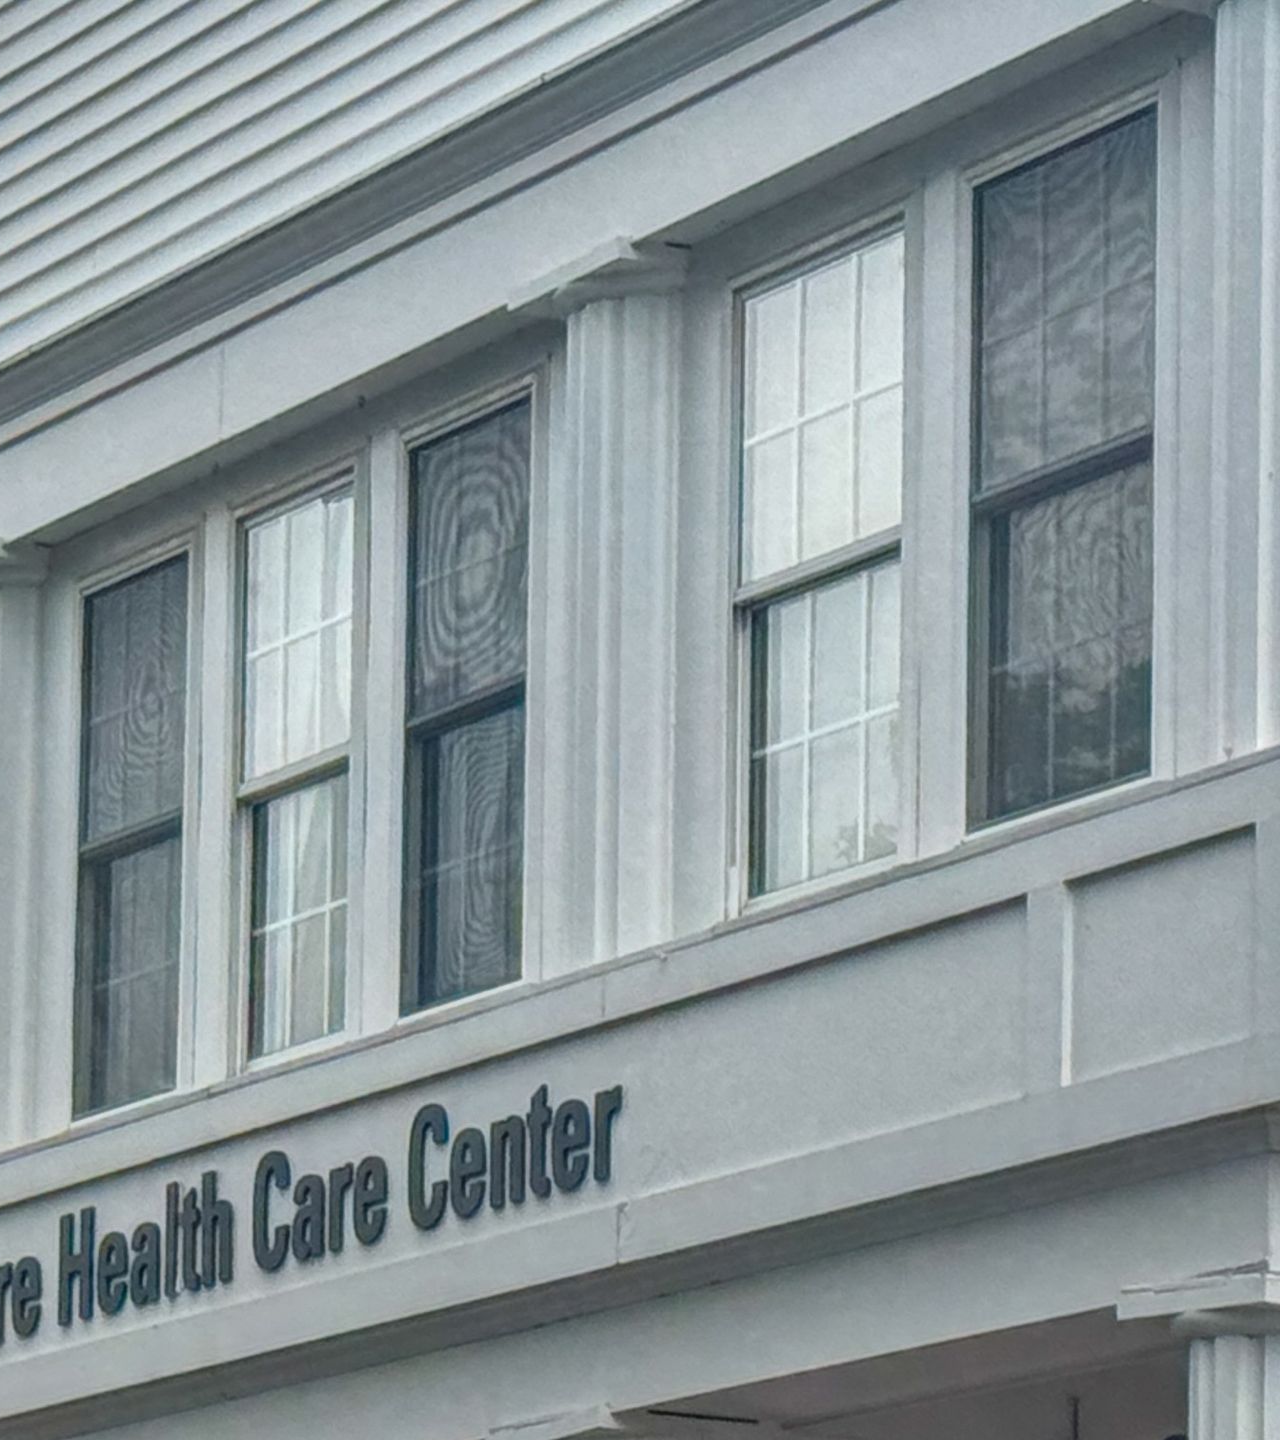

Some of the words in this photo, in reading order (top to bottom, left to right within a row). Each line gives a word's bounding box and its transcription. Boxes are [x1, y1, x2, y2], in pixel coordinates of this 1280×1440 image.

[58, 1171, 234, 1327] Health
[253, 1151, 389, 1272] Care
[409, 1083, 624, 1232] Center
